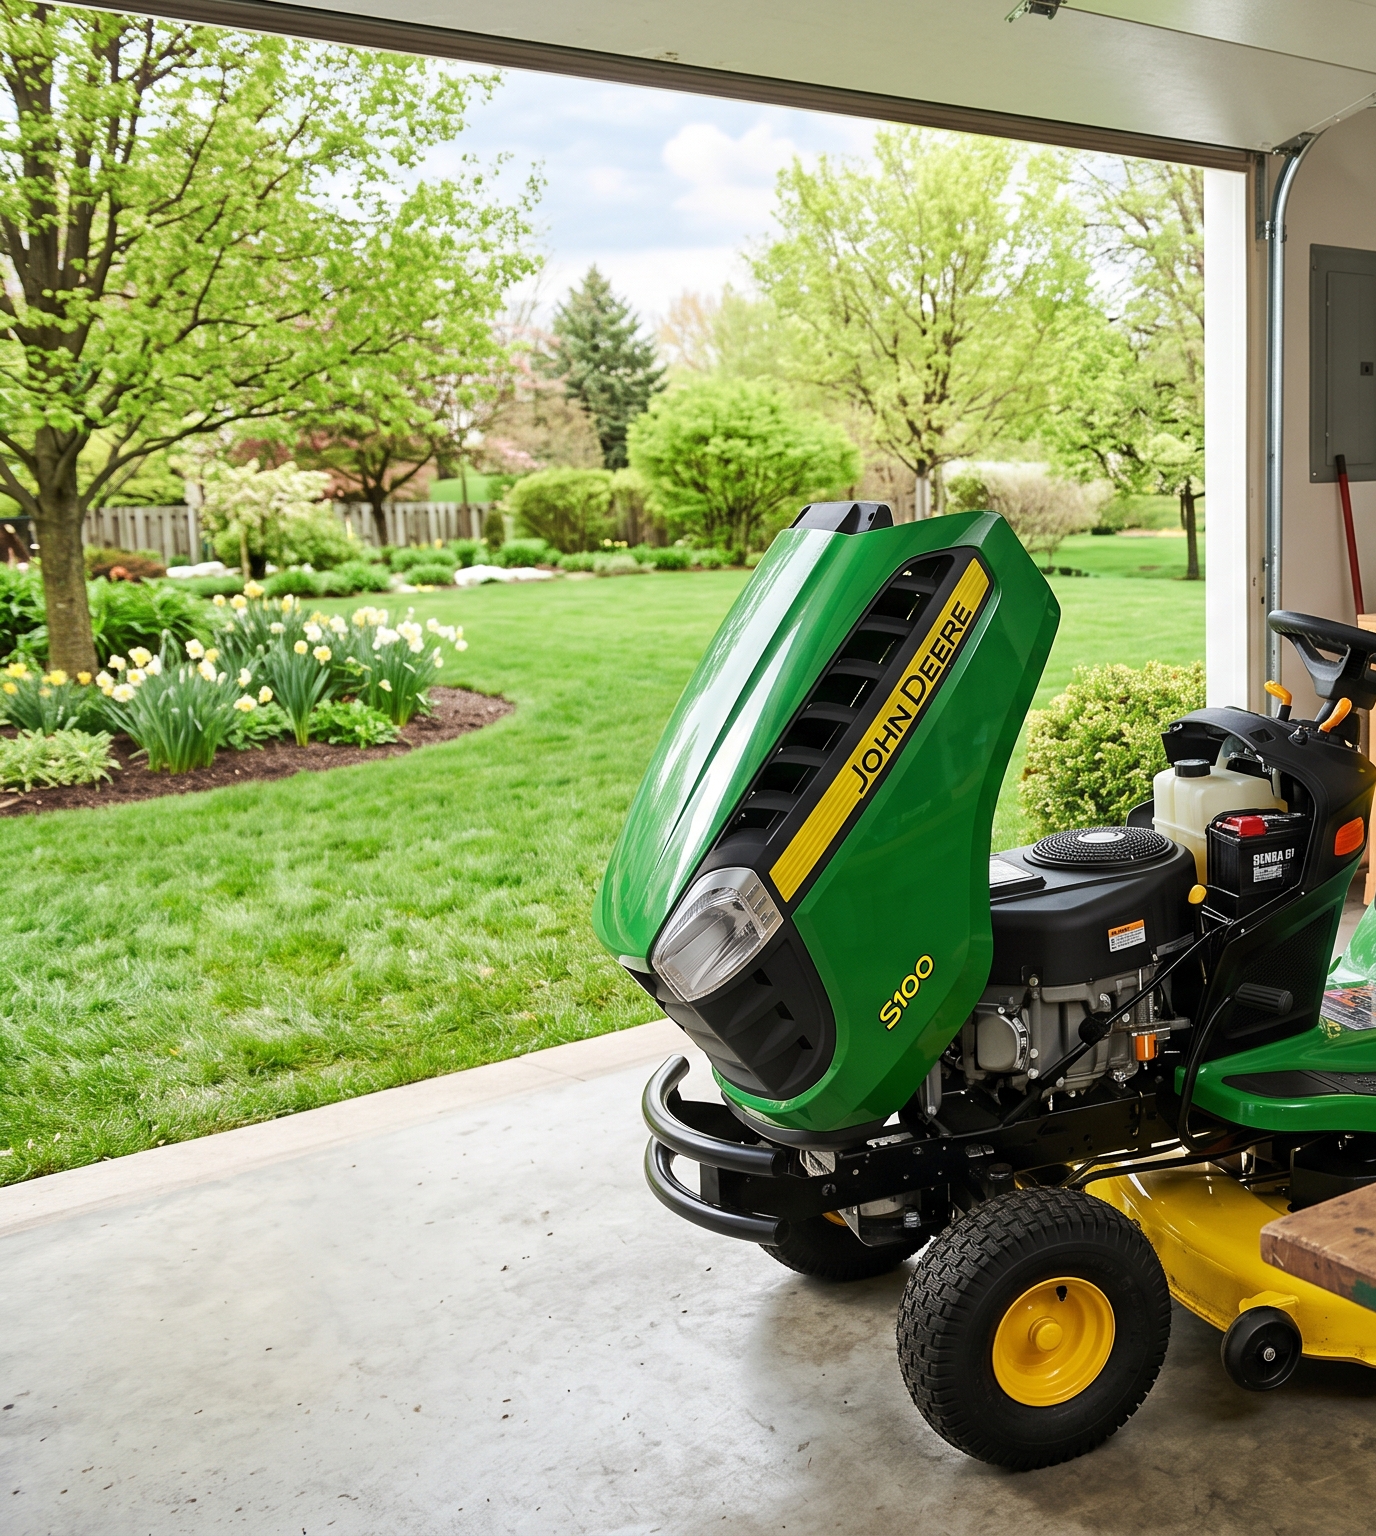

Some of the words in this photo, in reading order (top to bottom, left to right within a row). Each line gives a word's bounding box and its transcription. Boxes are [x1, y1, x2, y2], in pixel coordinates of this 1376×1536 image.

[851, 704, 912, 794] JOHN
[899, 600, 972, 706] DEERE
[879, 954, 934, 1031] S100
